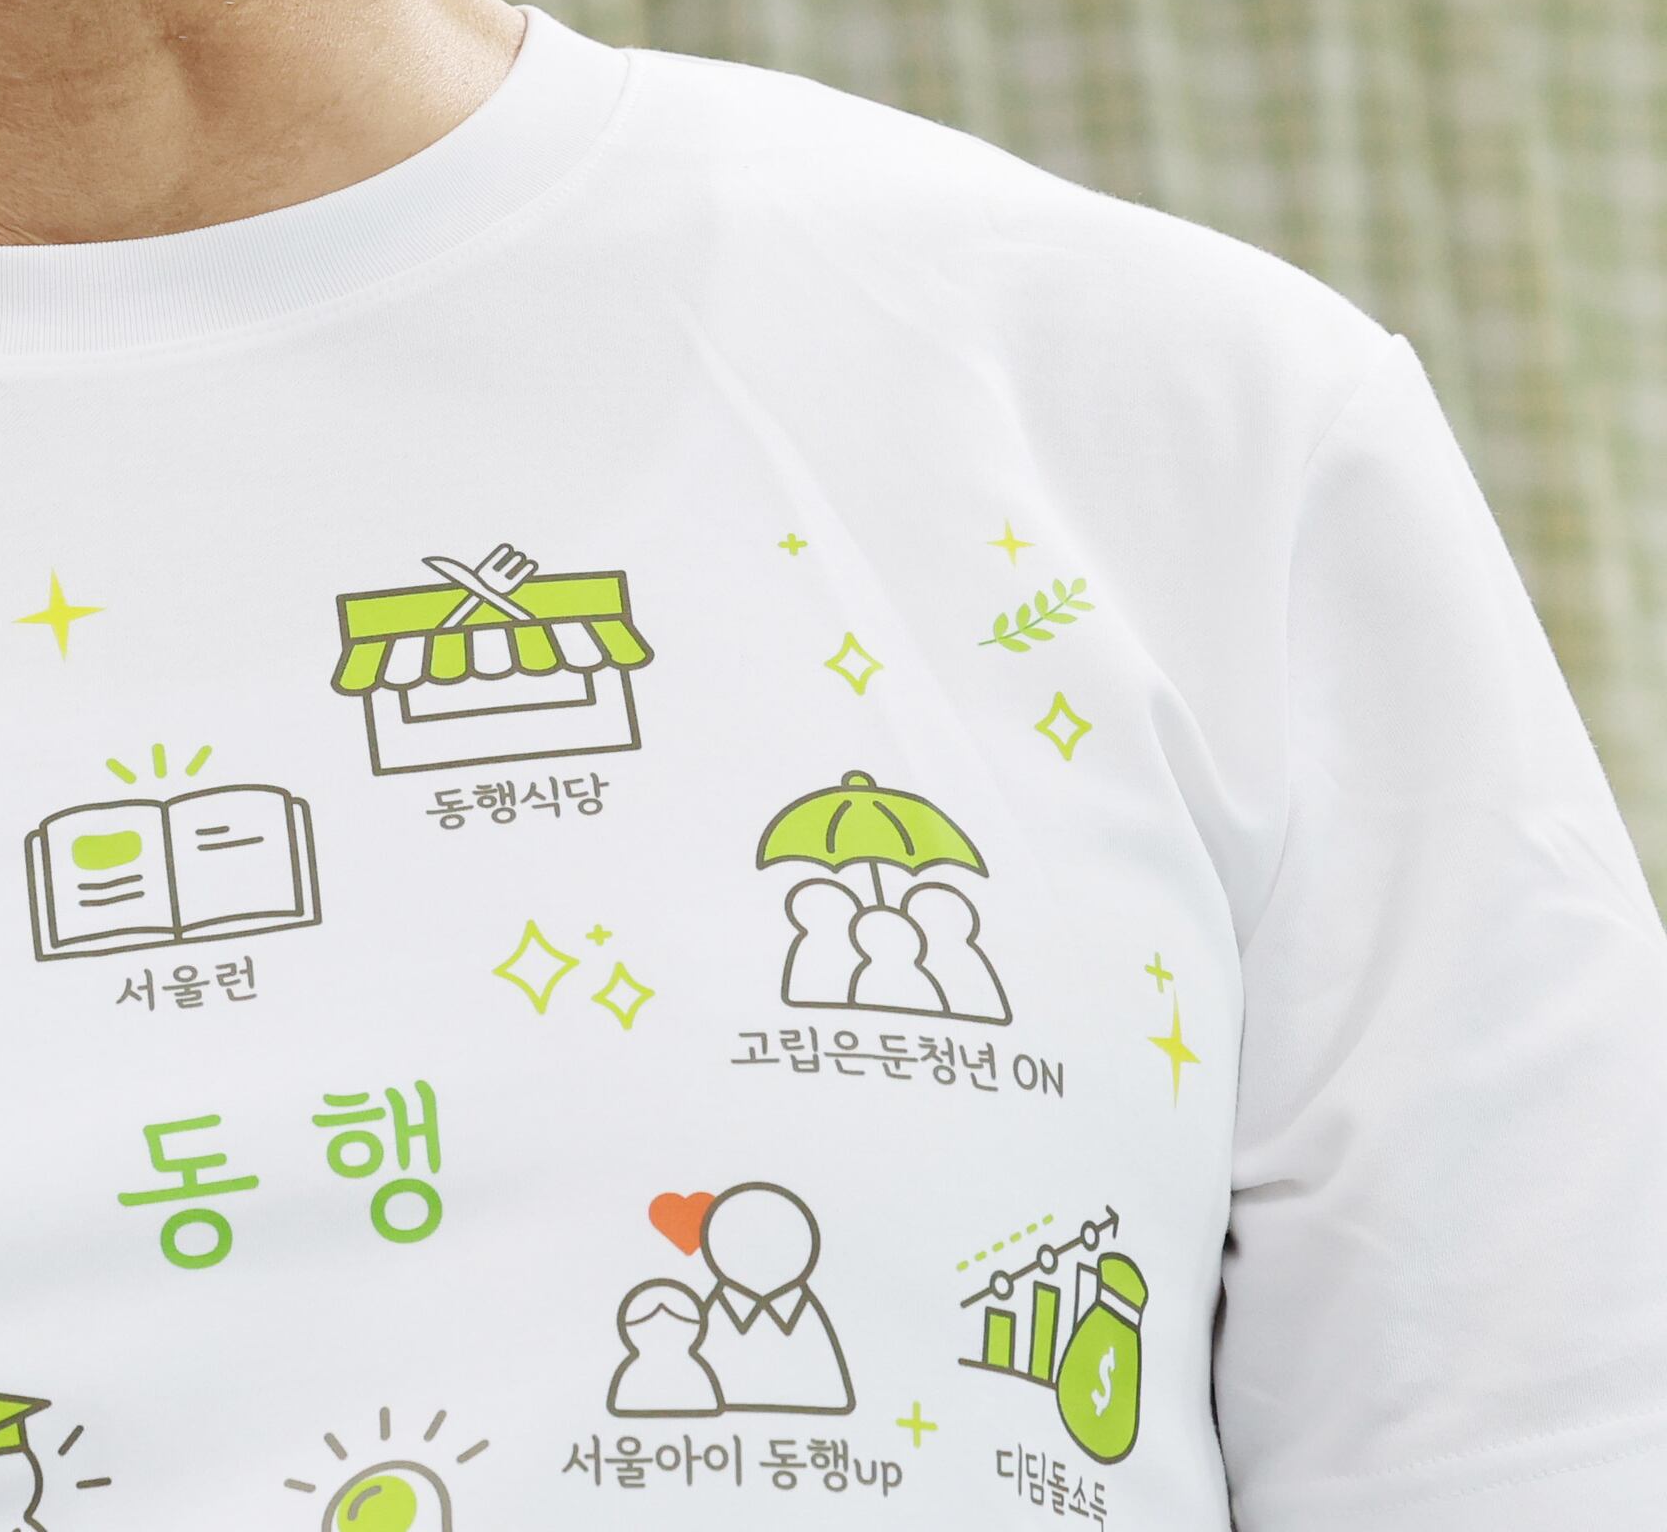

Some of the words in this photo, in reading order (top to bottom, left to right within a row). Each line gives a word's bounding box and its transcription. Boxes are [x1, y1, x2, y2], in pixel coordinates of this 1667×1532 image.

[425, 772, 610, 830] 동행식당
[115, 955, 258, 1011] 서울런
[730, 1026, 999, 1092] 고립은둔청년
[1012, 1054, 1065, 1098] ON
[562, 1434, 743, 1489] 서울아이
[759, 1436, 904, 1497] 동행up
[996, 1442, 1108, 1532] 디딤돌소득
